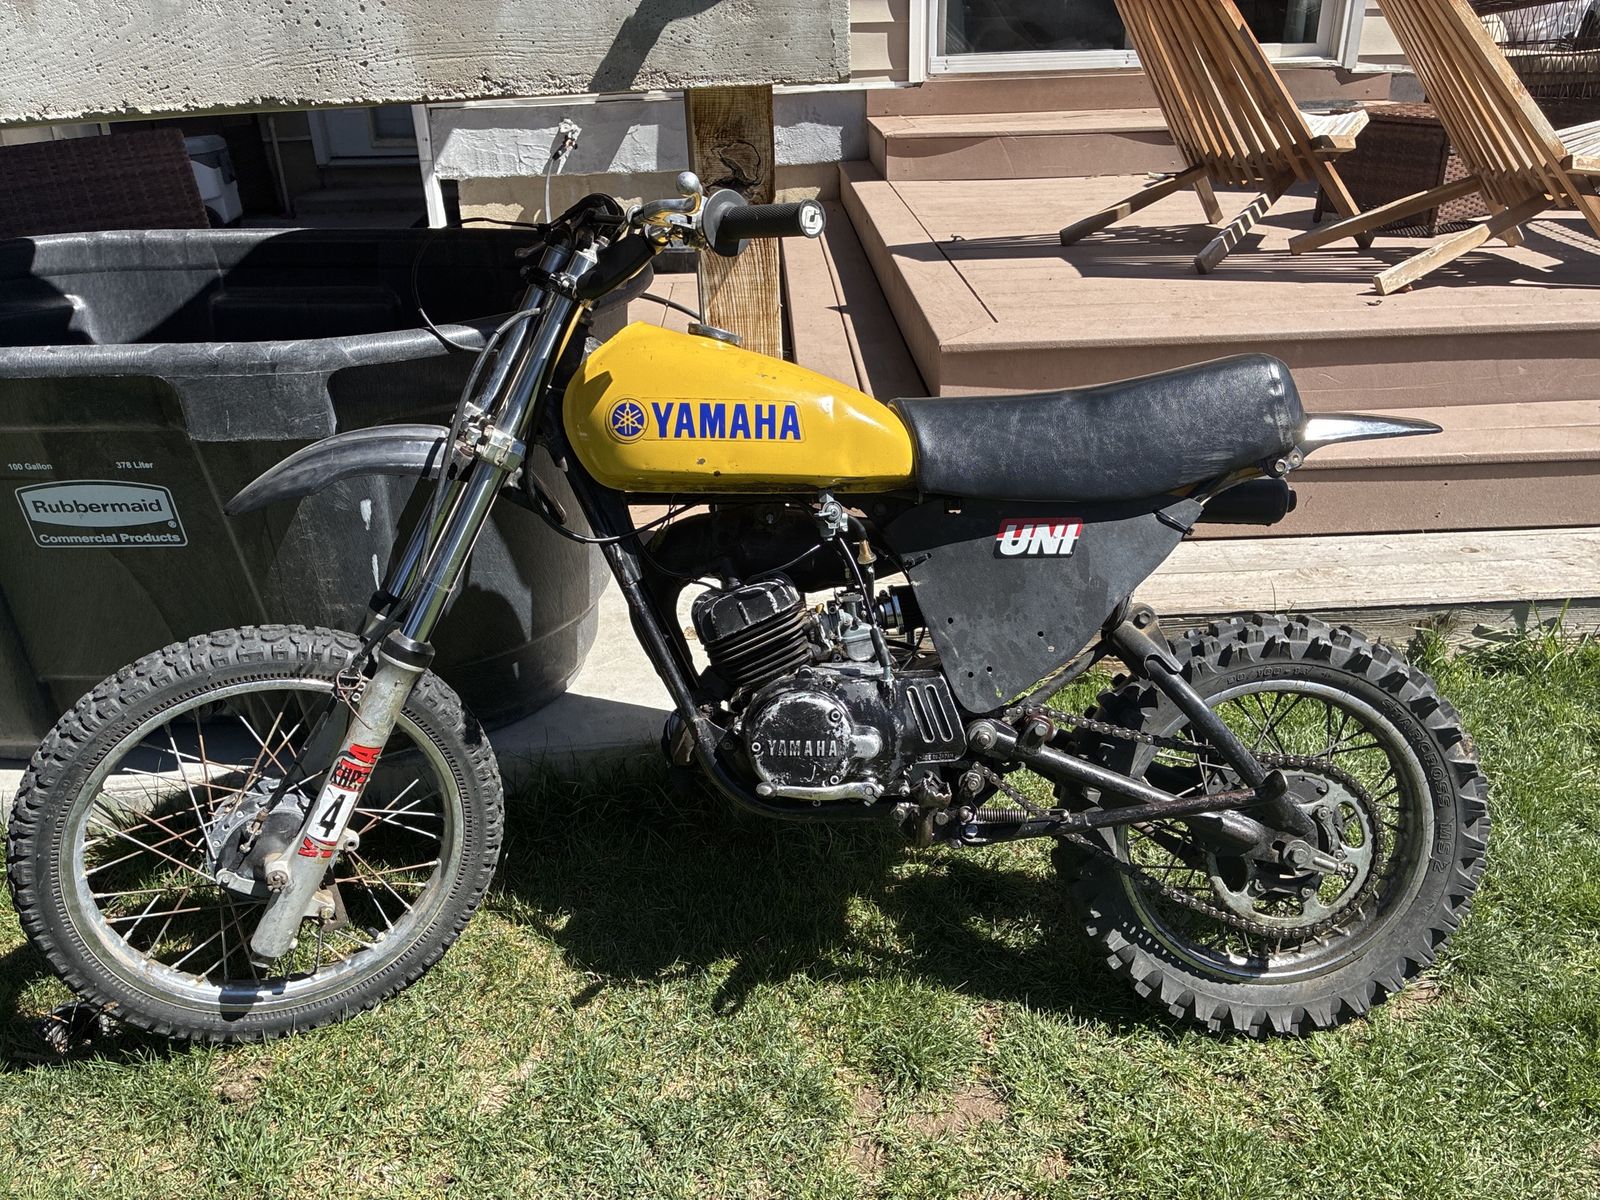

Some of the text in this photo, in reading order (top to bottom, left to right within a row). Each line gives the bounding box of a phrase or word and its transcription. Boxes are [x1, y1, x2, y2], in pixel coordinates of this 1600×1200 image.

[651, 402, 801, 440] YAMAHA
[8, 462, 53, 471] 100 Gallon
[115, 461, 154, 469] 378 Liter
[32, 499, 163, 514] Rubbermaid
[39, 533, 181, 544] Commercial Products
[999, 524, 1079, 556] UNI
[767, 739, 838, 757] YAMAHA
[319, 794, 346, 838] 4
